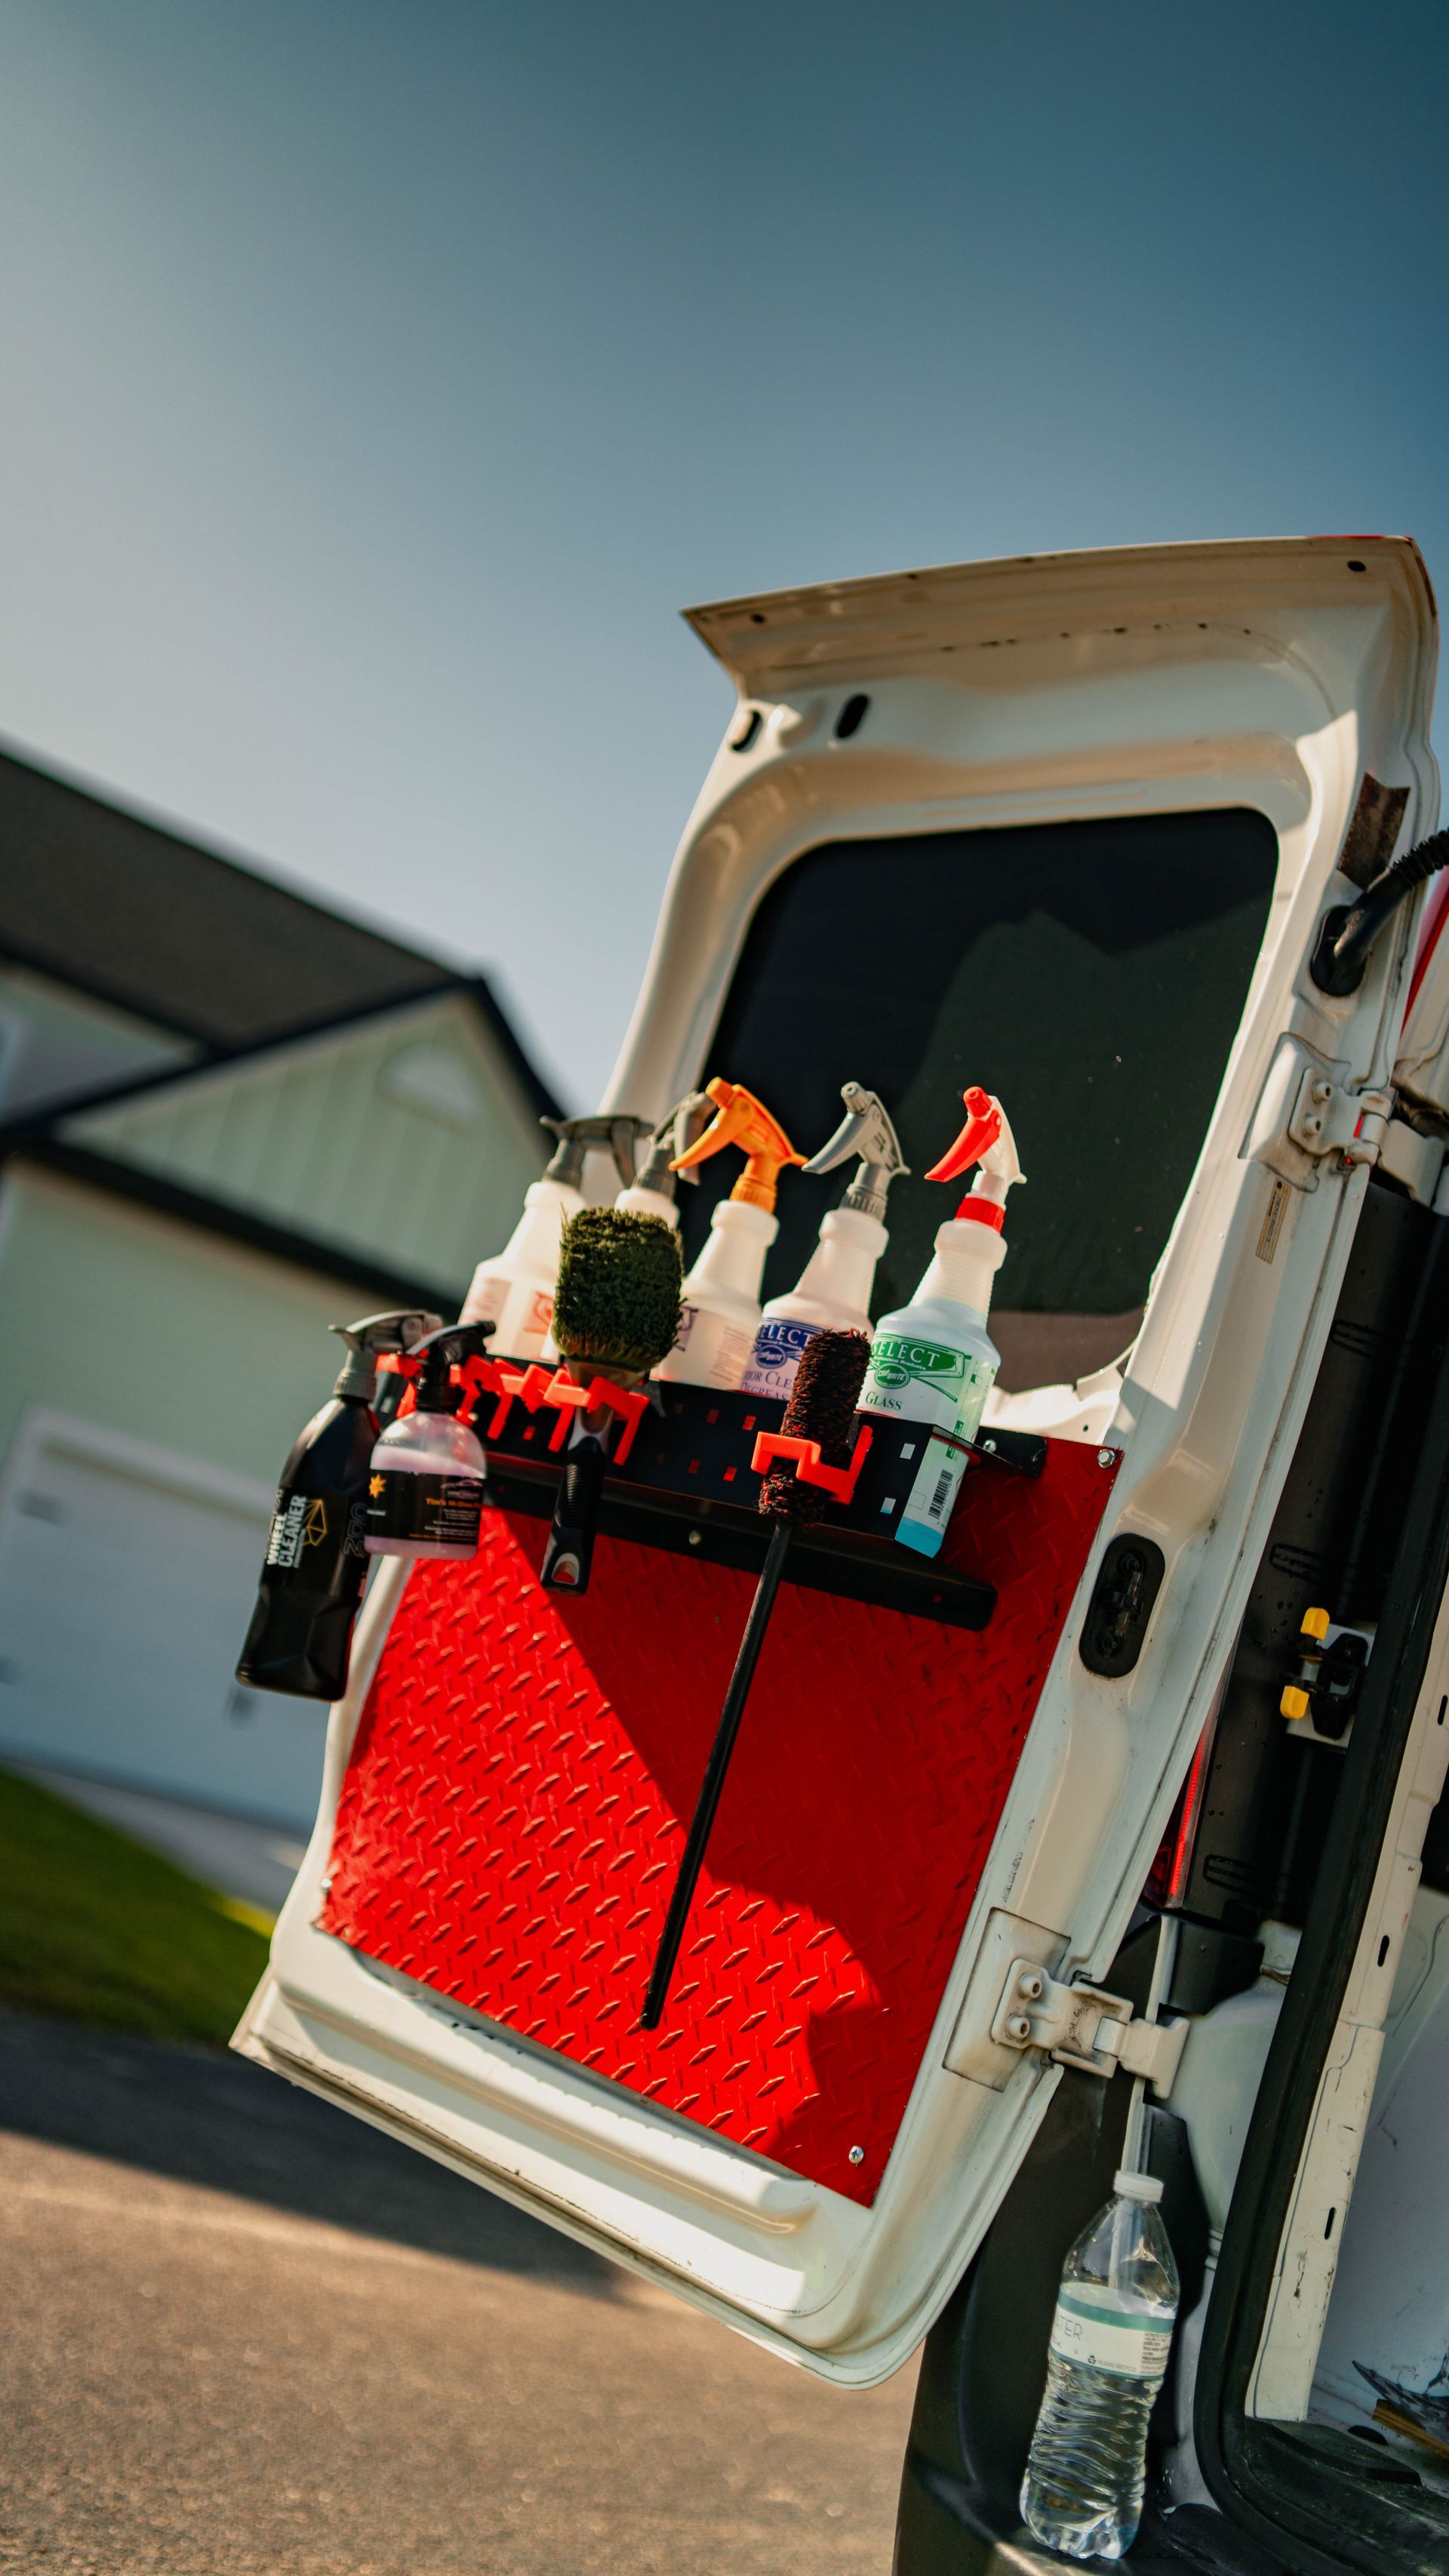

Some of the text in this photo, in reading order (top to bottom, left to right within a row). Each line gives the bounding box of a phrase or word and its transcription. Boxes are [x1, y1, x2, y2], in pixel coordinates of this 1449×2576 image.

[760, 1324, 815, 1348] ELECT
[872, 1340, 940, 1368] SELECT
[866, 1391, 903, 1411] GLASS
[266, 1512, 288, 1565] WHEEL
[278, 1495, 307, 1568] CLEANER
